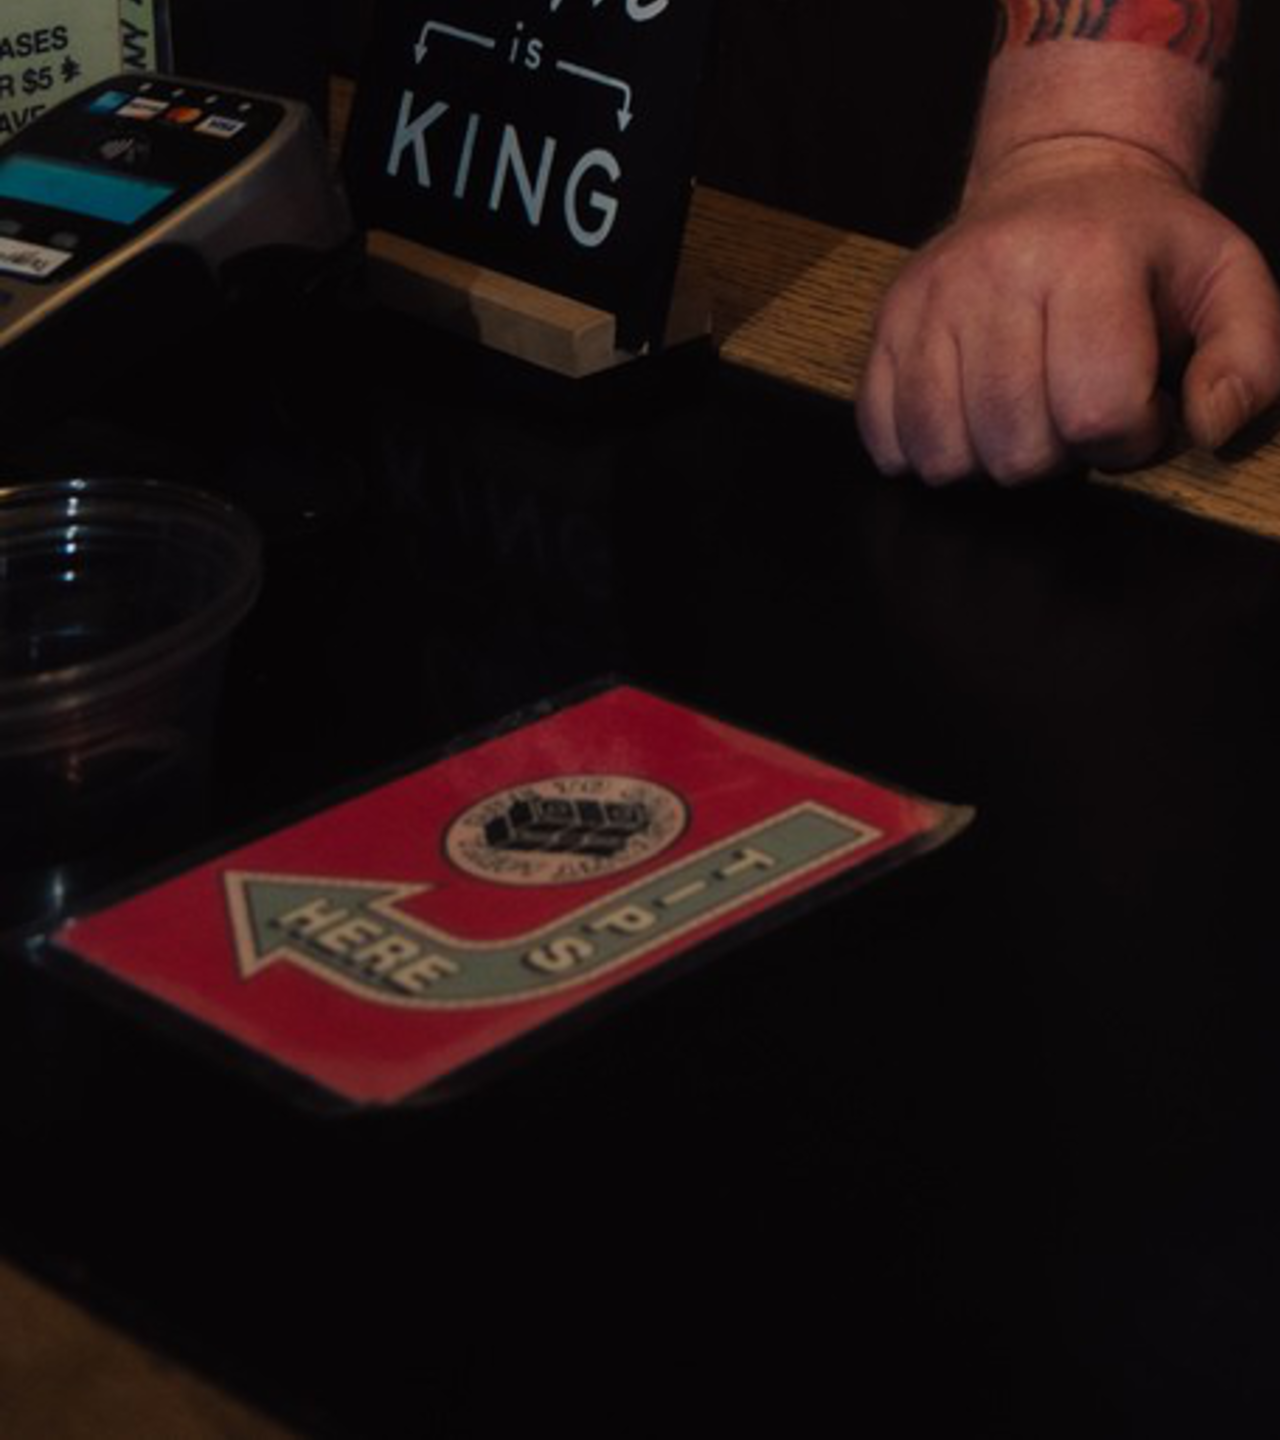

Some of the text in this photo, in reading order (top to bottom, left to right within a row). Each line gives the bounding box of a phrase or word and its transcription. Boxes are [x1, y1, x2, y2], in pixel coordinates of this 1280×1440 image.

[510, 21, 542, 72] is
[386, 88, 623, 250] KING
[273, 896, 458, 996] HERE
[522, 846, 777, 977] TIPS
